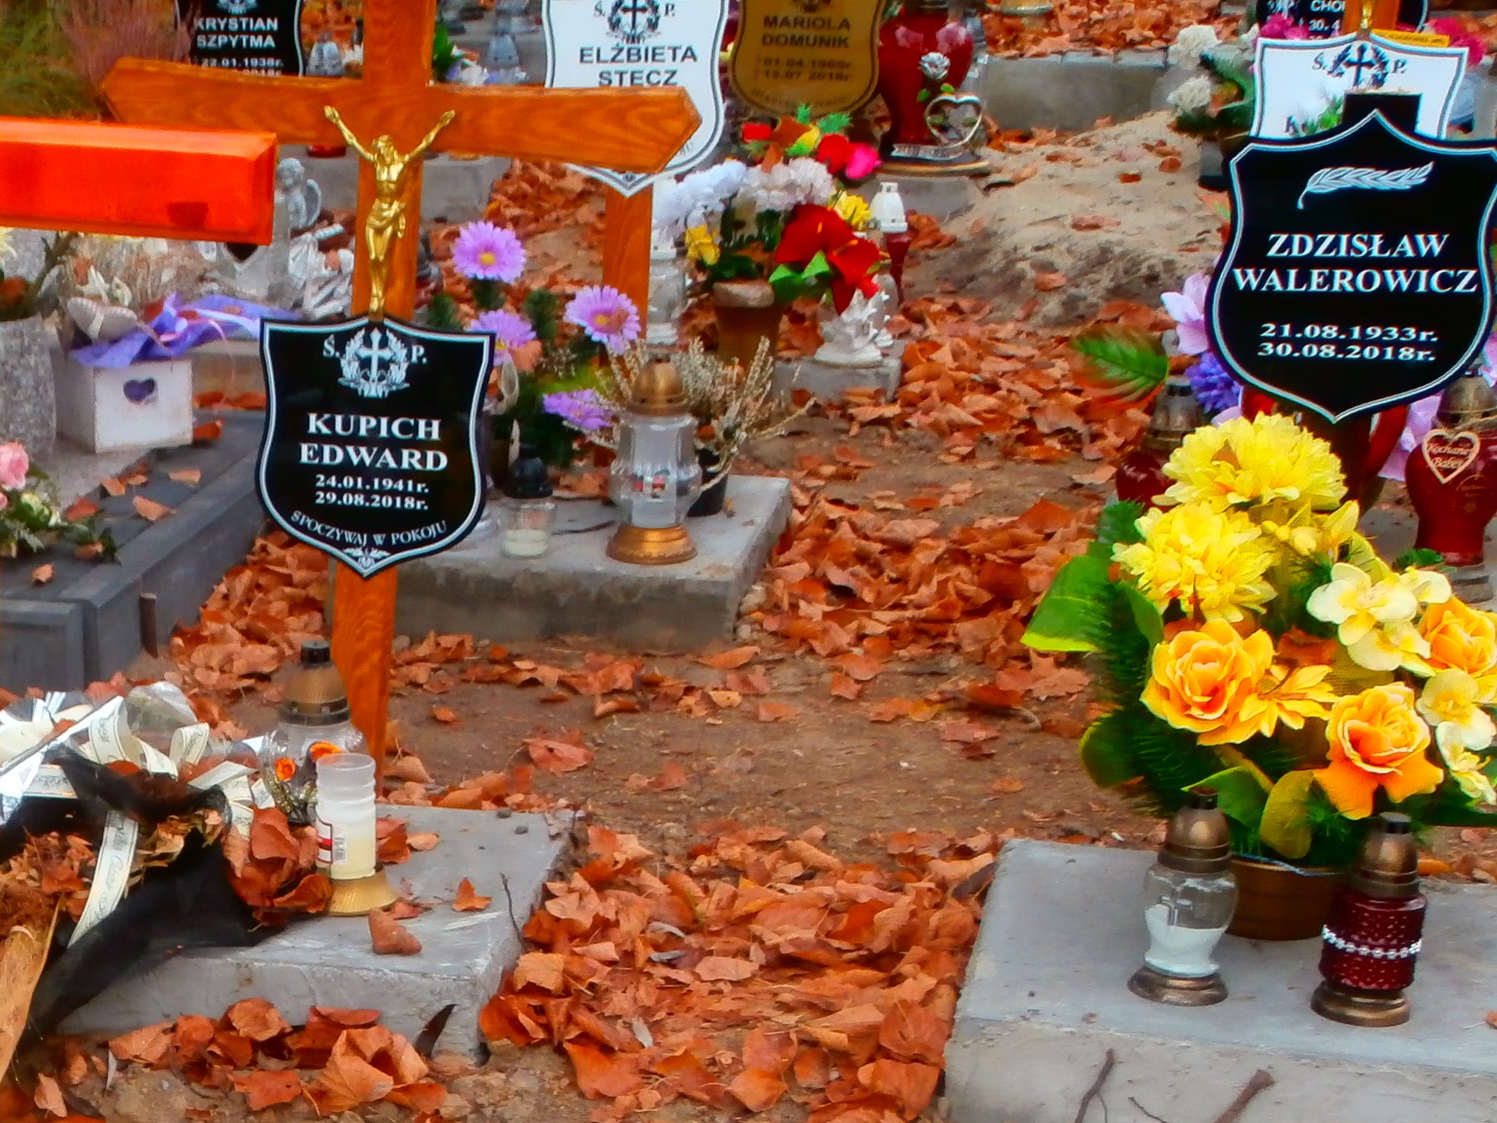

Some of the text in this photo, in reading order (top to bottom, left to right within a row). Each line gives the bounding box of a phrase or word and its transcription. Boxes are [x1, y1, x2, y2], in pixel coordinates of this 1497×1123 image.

[763, 15, 851, 31] MARIOLA
[196, 34, 277, 49] SZPYTMA
[762, 33, 850, 49] DOMUNIK
[579, 43, 698, 65] ELŻBIETA
[598, 69, 679, 87] STECZ
[1265, 233, 1450, 258] ZDZISŁAW
[1231, 268, 1479, 293] WALEROWICZ
[1260, 322, 1439, 342] 21.08.1933r.
[1257, 342, 1437, 361] 30.08.2018r.
[307, 412, 442, 441] KUPICH
[299, 442, 449, 472] EDWARD
[314, 474, 430, 494] 24.01.1941r.
[314, 491, 429, 510] 29.08.2018r.
[290, 510, 448, 547] SPOCZYWAJ W POKOJU
